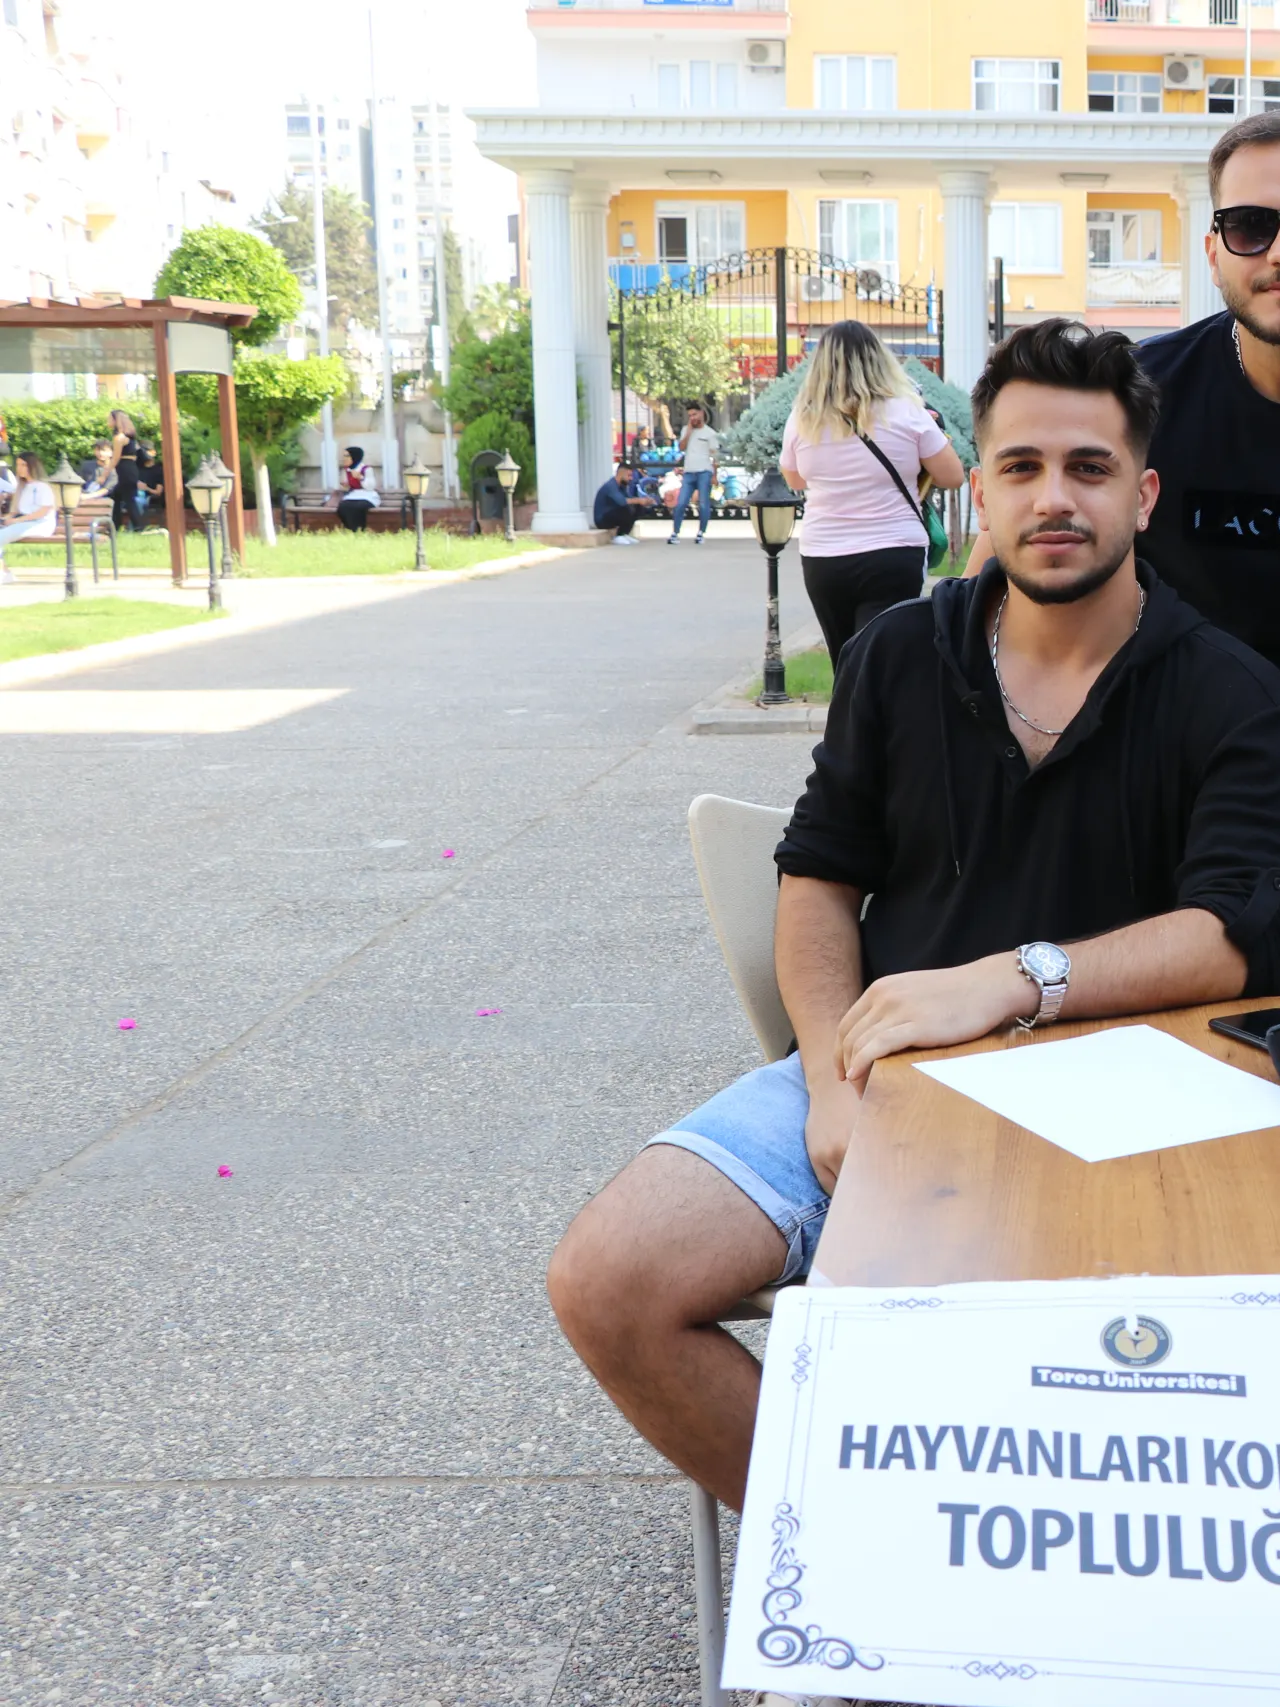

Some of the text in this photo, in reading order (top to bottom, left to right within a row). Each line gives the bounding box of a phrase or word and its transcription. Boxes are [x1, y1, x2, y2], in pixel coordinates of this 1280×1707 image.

[1037, 1368, 1237, 1391] Toros Üniversitesi
[838, 1425, 1188, 1484] HAYVANLARI
